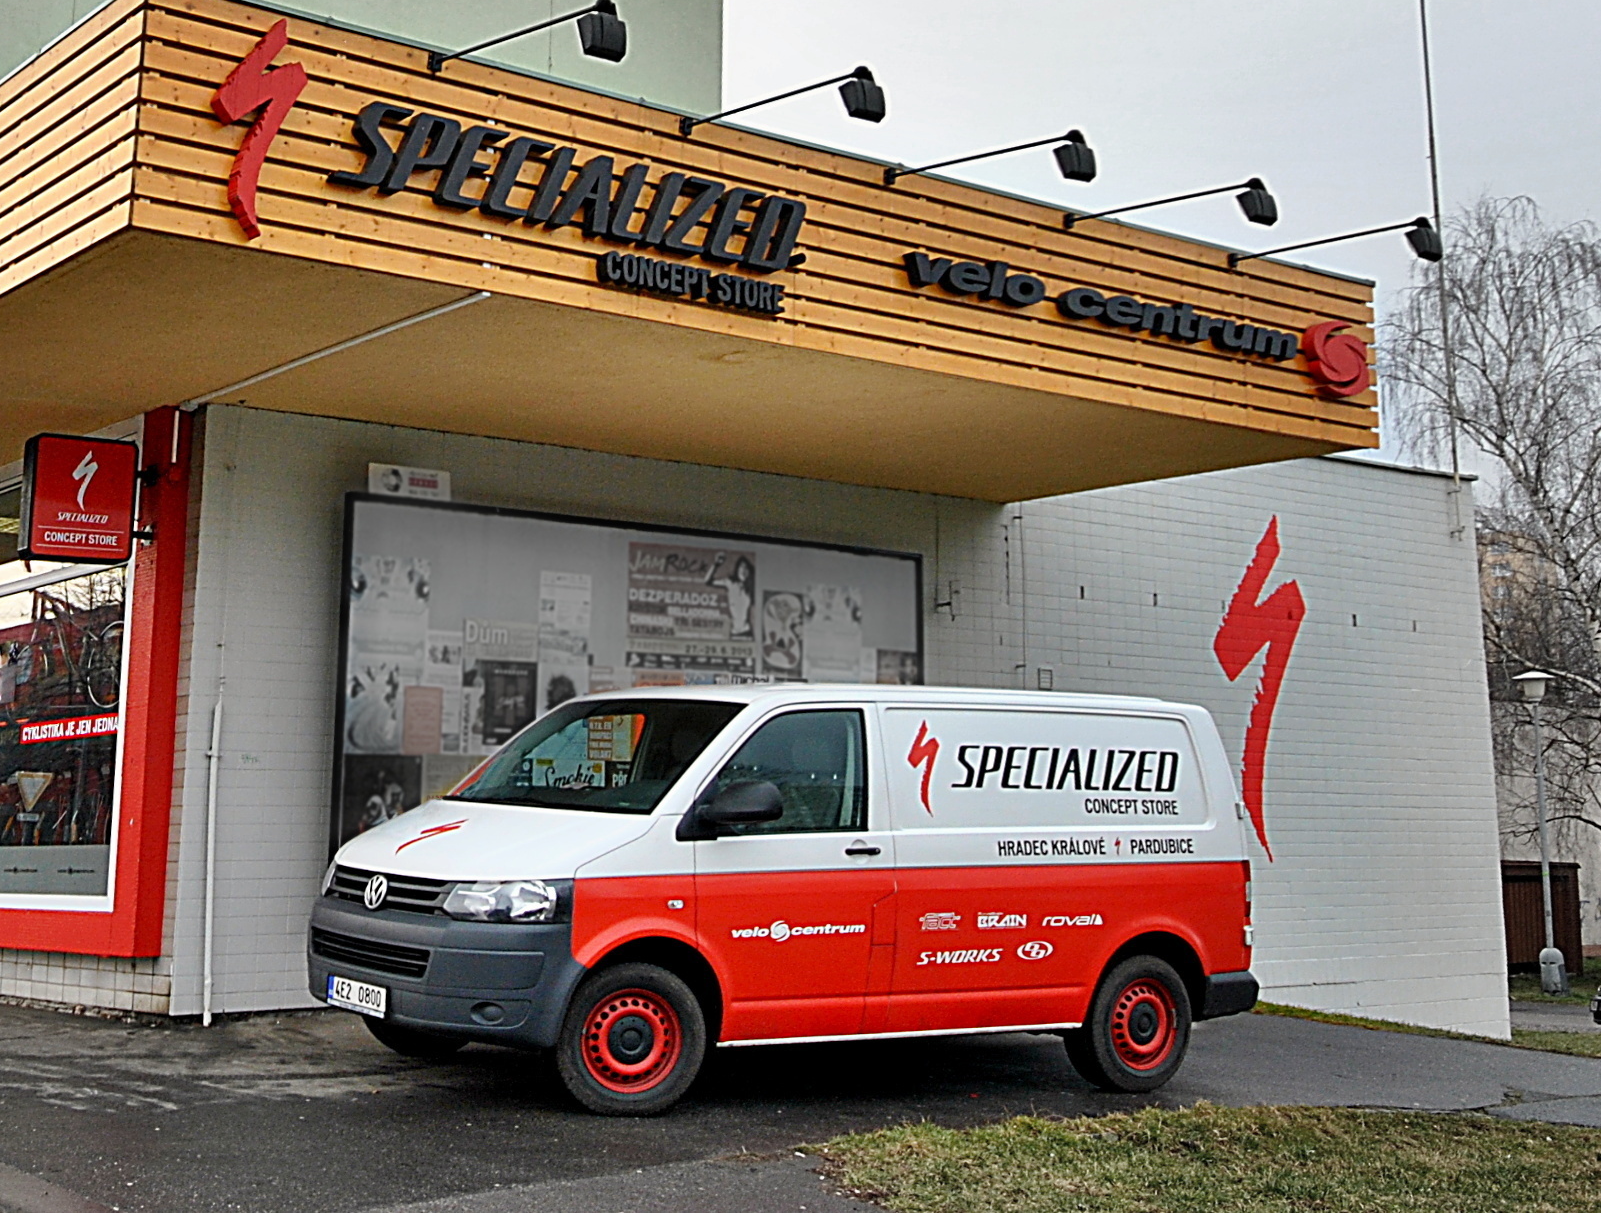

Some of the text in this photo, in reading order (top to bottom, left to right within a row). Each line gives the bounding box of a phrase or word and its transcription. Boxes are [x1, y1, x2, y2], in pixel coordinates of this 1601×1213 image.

[327, 100, 807, 272] SPECIALIZED
[599, 250, 786, 314] CONCEPT STORE
[903, 251, 1300, 361] velo centrum
[56, 511, 109, 525] SPECIALIZED
[44, 530, 118, 546] CONCEPT STORE
[22, 723, 65, 742] CYKLISTIKA
[65, 722, 76, 737] JE
[75, 719, 92, 735] JEN
[951, 745, 1179, 793] SPECIALIZED
[1084, 798, 1179, 815] CONCEPT STORE
[997, 836, 1194, 857] HRADEC KRÁLOVÉ PARDUBICE
[731, 923, 866, 938] velo centrum
[977, 913, 1027, 929] BRAIN
[1042, 913, 1096, 927] roval
[916, 947, 1004, 966] S-WORKS
[335, 979, 352, 1000] 4E2
[358, 985, 382, 1008] 0800
